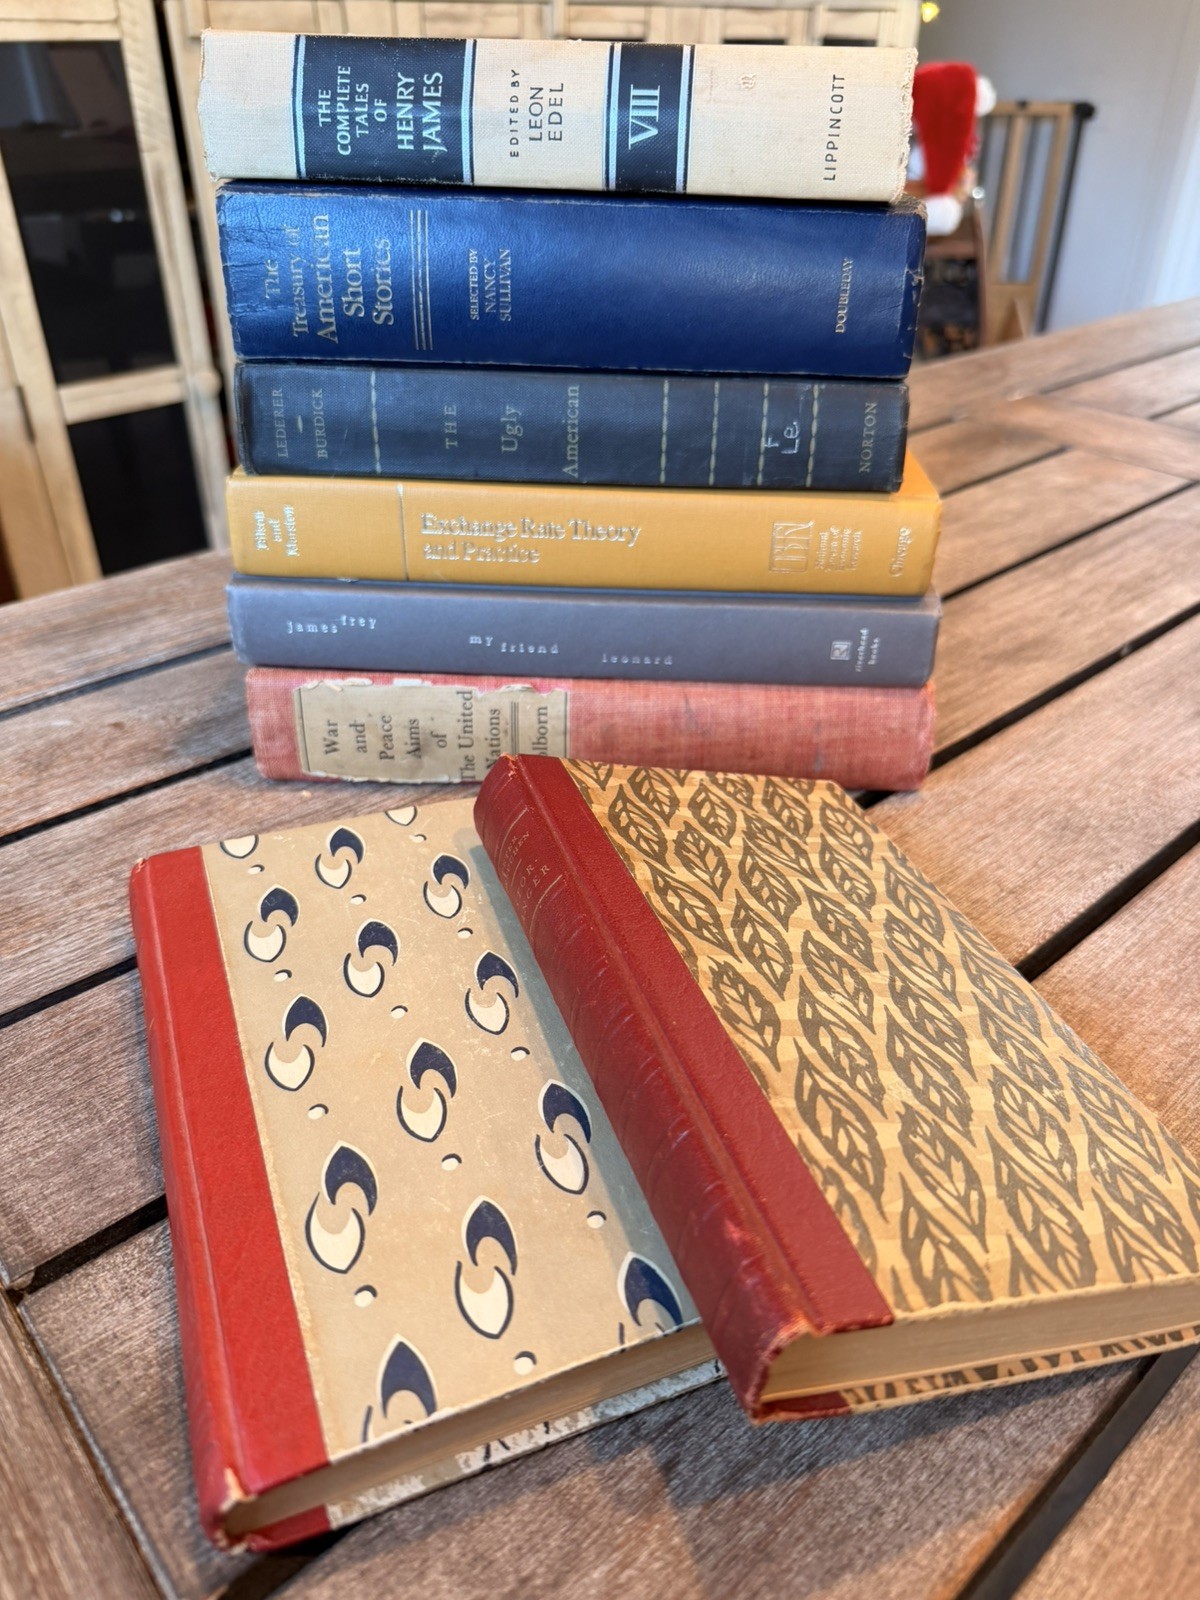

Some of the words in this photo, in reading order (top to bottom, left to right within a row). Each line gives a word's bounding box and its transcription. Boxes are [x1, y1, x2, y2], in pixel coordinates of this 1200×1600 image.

[511, 69, 520, 87] BY
[318, 89, 332, 127] THE
[337, 66, 351, 156] COMPLETE
[355, 82, 370, 138] TALES
[374, 98, 387, 123] OF
[396, 72, 415, 151] HENRY
[423, 71, 447, 152] JAMES
[509, 94, 519, 158] EDITED
[528, 86, 544, 143] LEON
[548, 82, 564, 142] EDEL
[628, 84, 660, 150] VIII
[823, 74, 845, 181] LIPPINCOTT
[264, 259, 280, 299] The
[310, 213, 339, 343] American
[341, 247, 365, 317] Short
[371, 237, 395, 325] Stories
[469, 249, 478, 264] BY
[289, 254, 309, 337] Treasury
[469, 267, 480, 320] SELECTED
[485, 258, 497, 313] NANCY
[500, 249, 511, 322] SULLIVAN
[835, 257, 853, 333] DOUBLEDAY
[274, 389, 288, 458] LEDERER
[313, 389, 328, 458] BURDICK
[445, 404, 458, 448] THE
[500, 405, 524, 454] Ugly
[561, 385, 579, 478] American
[859, 402, 878, 473] NORTON
[421, 512, 517, 542] Exchange
[520, 517, 566, 539] Rate
[568, 518, 642, 547] Theory
[424, 541, 459, 560] and
[462, 541, 540, 563] Practice
[286, 621, 338, 634] james
[340, 614, 377, 629] frey
[469, 635, 493, 646] my
[500, 642, 559, 654] friend
[602, 653, 673, 665] leonard
[323, 719, 340, 755] War
[349, 721, 366, 754] and
[380, 714, 396, 761] Peace
[404, 718, 421, 759] Aims
[432, 731, 448, 749] of
[456, 691, 474, 749] United
[532, 706, 548, 755] lborn
[460, 755, 476, 780] The
